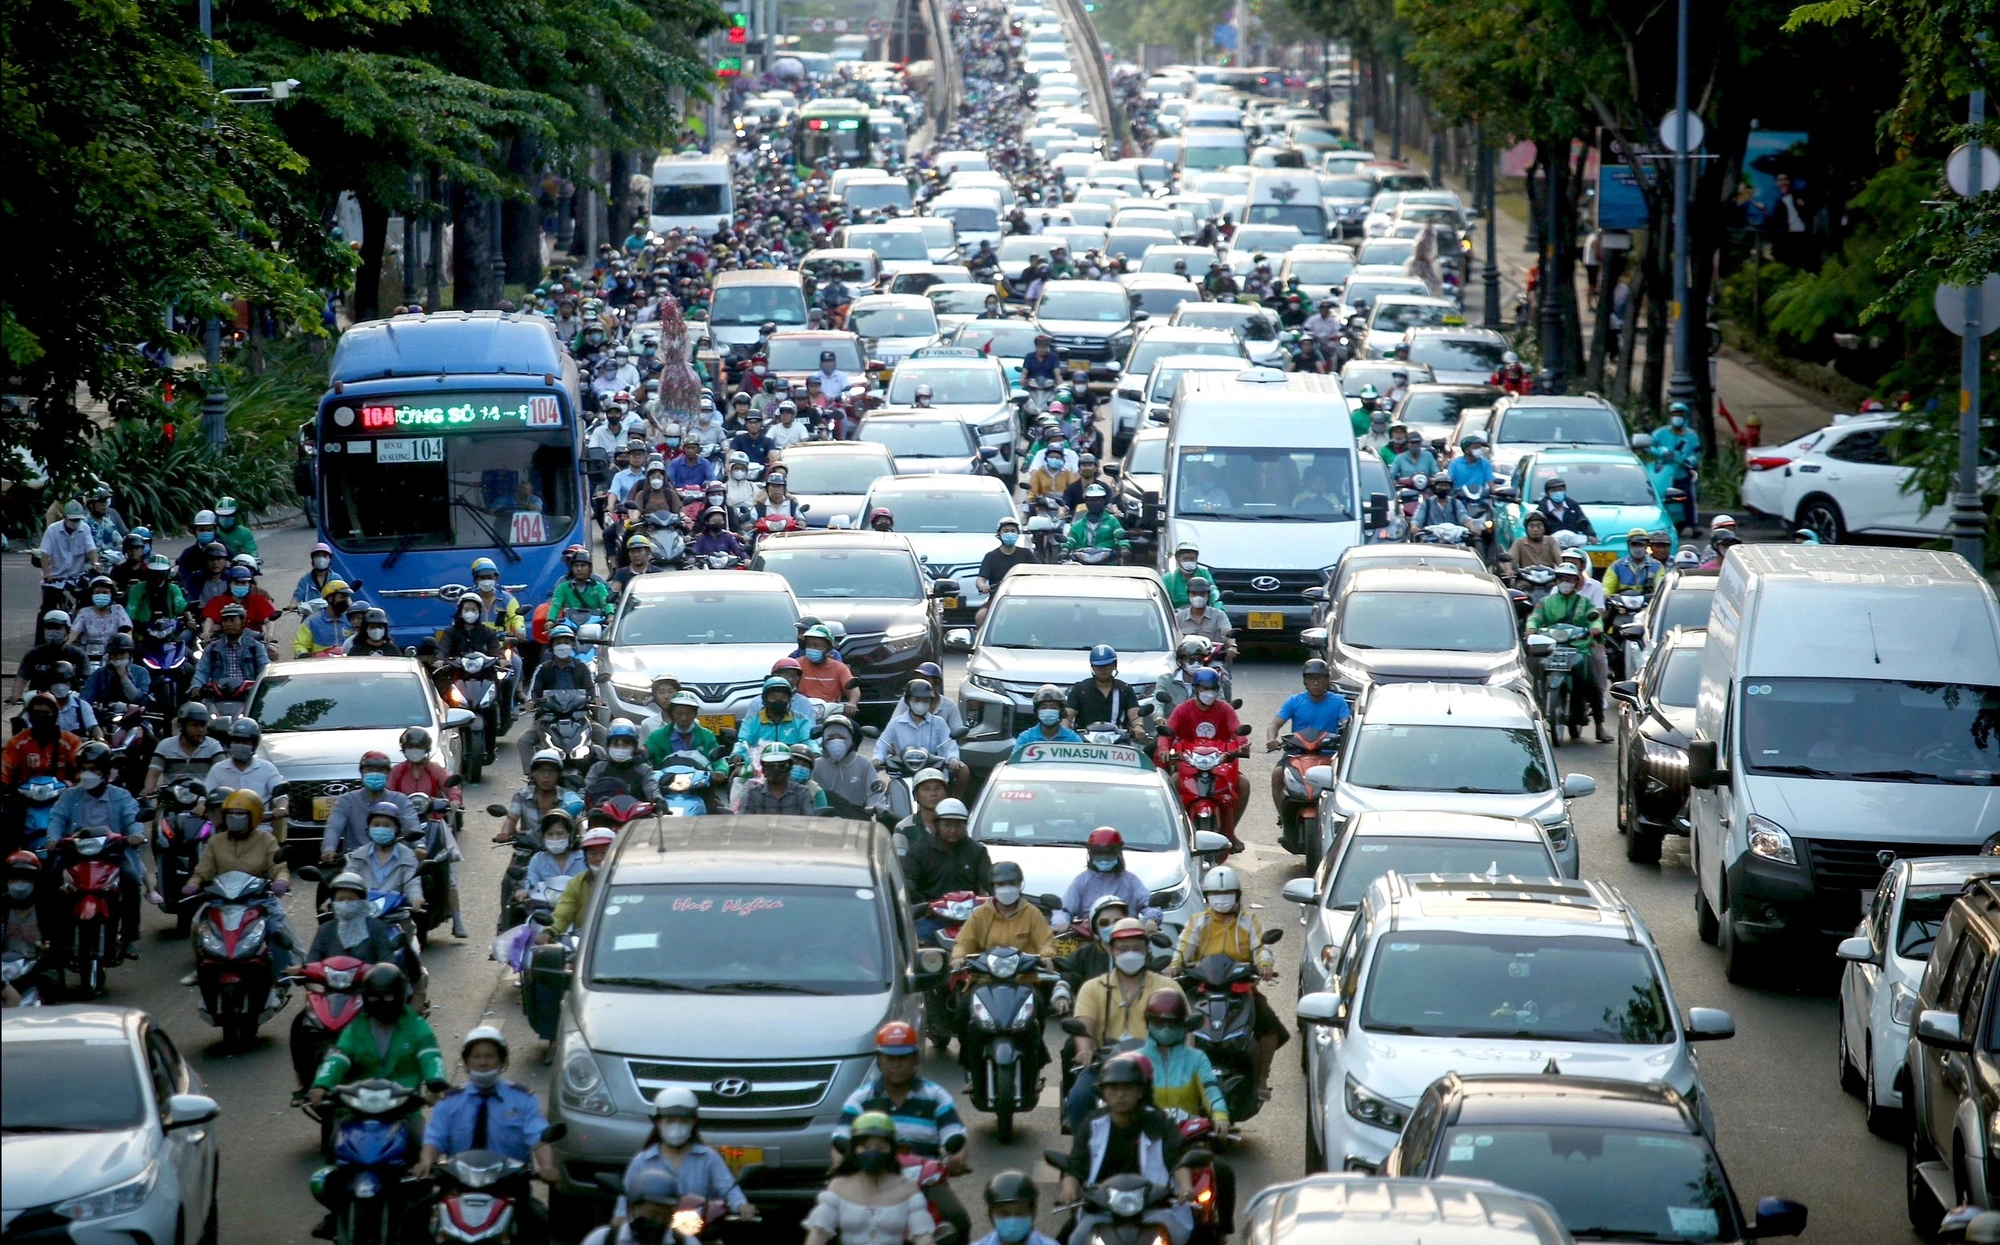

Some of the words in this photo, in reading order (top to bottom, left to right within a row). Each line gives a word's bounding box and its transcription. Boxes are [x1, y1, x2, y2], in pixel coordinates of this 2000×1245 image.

[362, 407, 395, 426] 104
[529, 397, 558, 424] 104
[412, 438, 442, 461] 104
[513, 514, 542, 543] 104
[1050, 747, 1108, 760] VINASUN
[1111, 751, 1136, 762] TAXI
